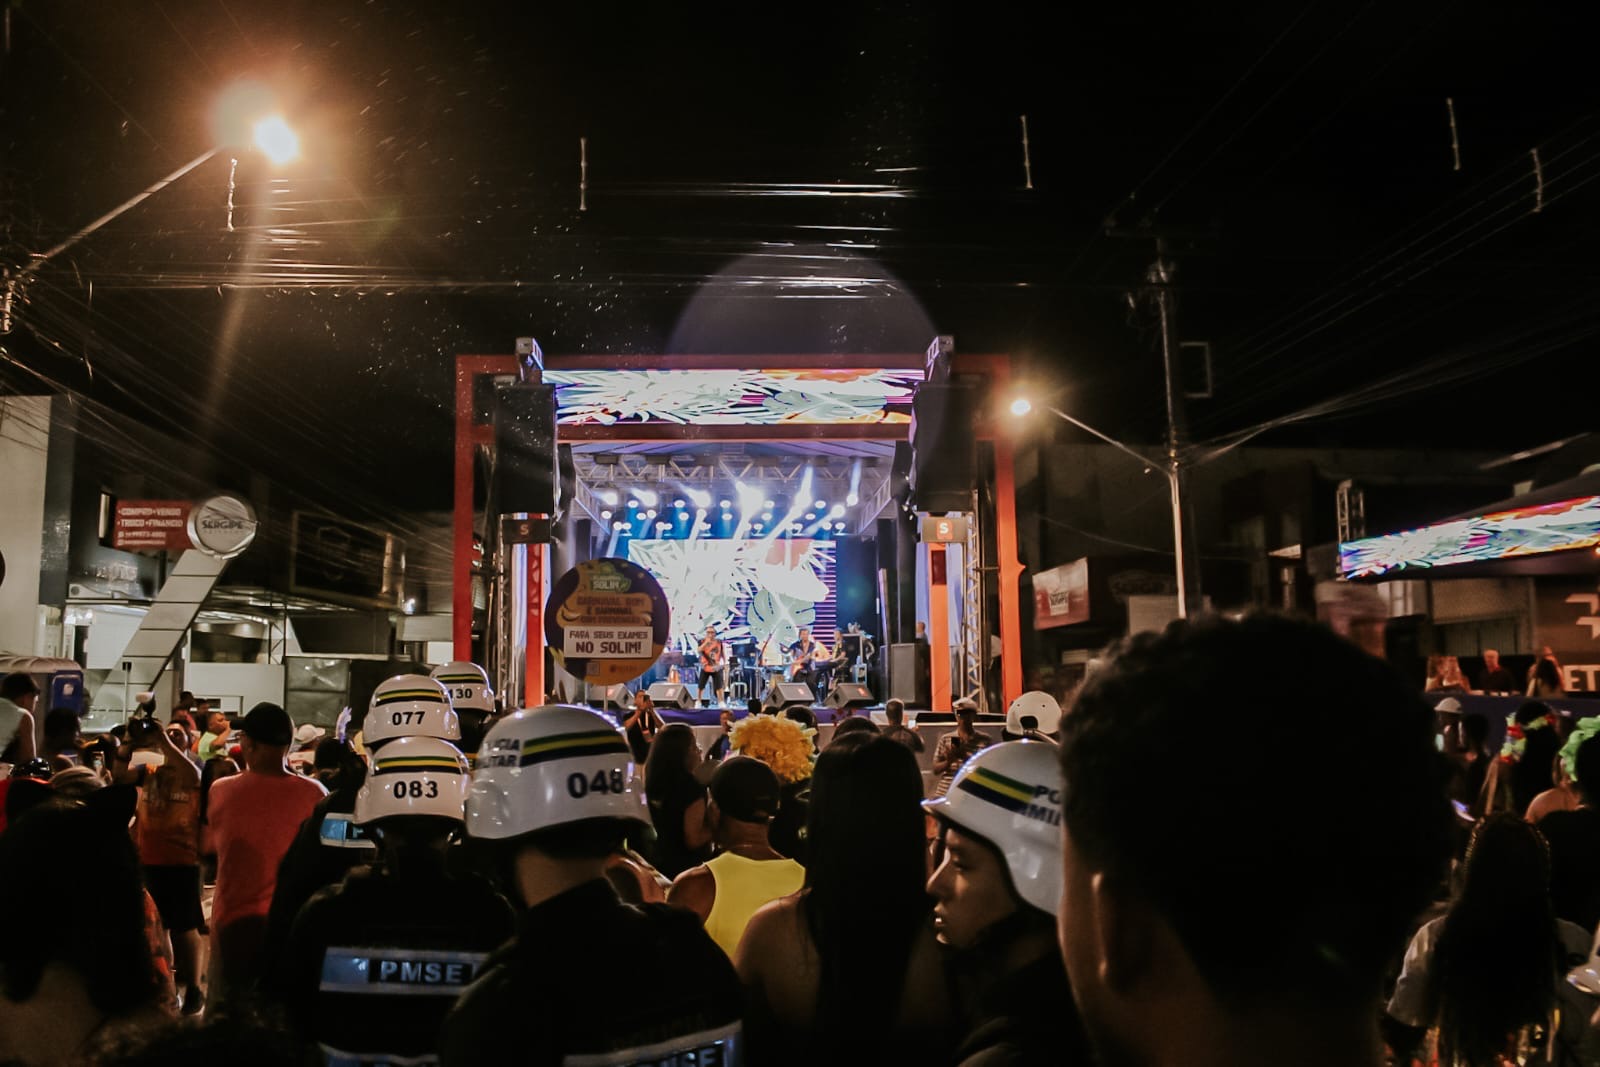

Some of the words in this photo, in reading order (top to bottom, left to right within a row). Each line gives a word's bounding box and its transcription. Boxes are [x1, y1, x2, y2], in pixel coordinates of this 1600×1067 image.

[202, 519, 244, 529] SERGIPE
[939, 522, 949, 534] S
[593, 631, 614, 639] SEUS
[617, 630, 648, 640] EXAMES
[575, 641, 594, 654] NO
[600, 641, 642, 654] SOLIM!
[391, 711, 426, 726] 077
[393, 779, 439, 800] 083
[566, 768, 625, 799] 048
[379, 959, 463, 985] PMSE
